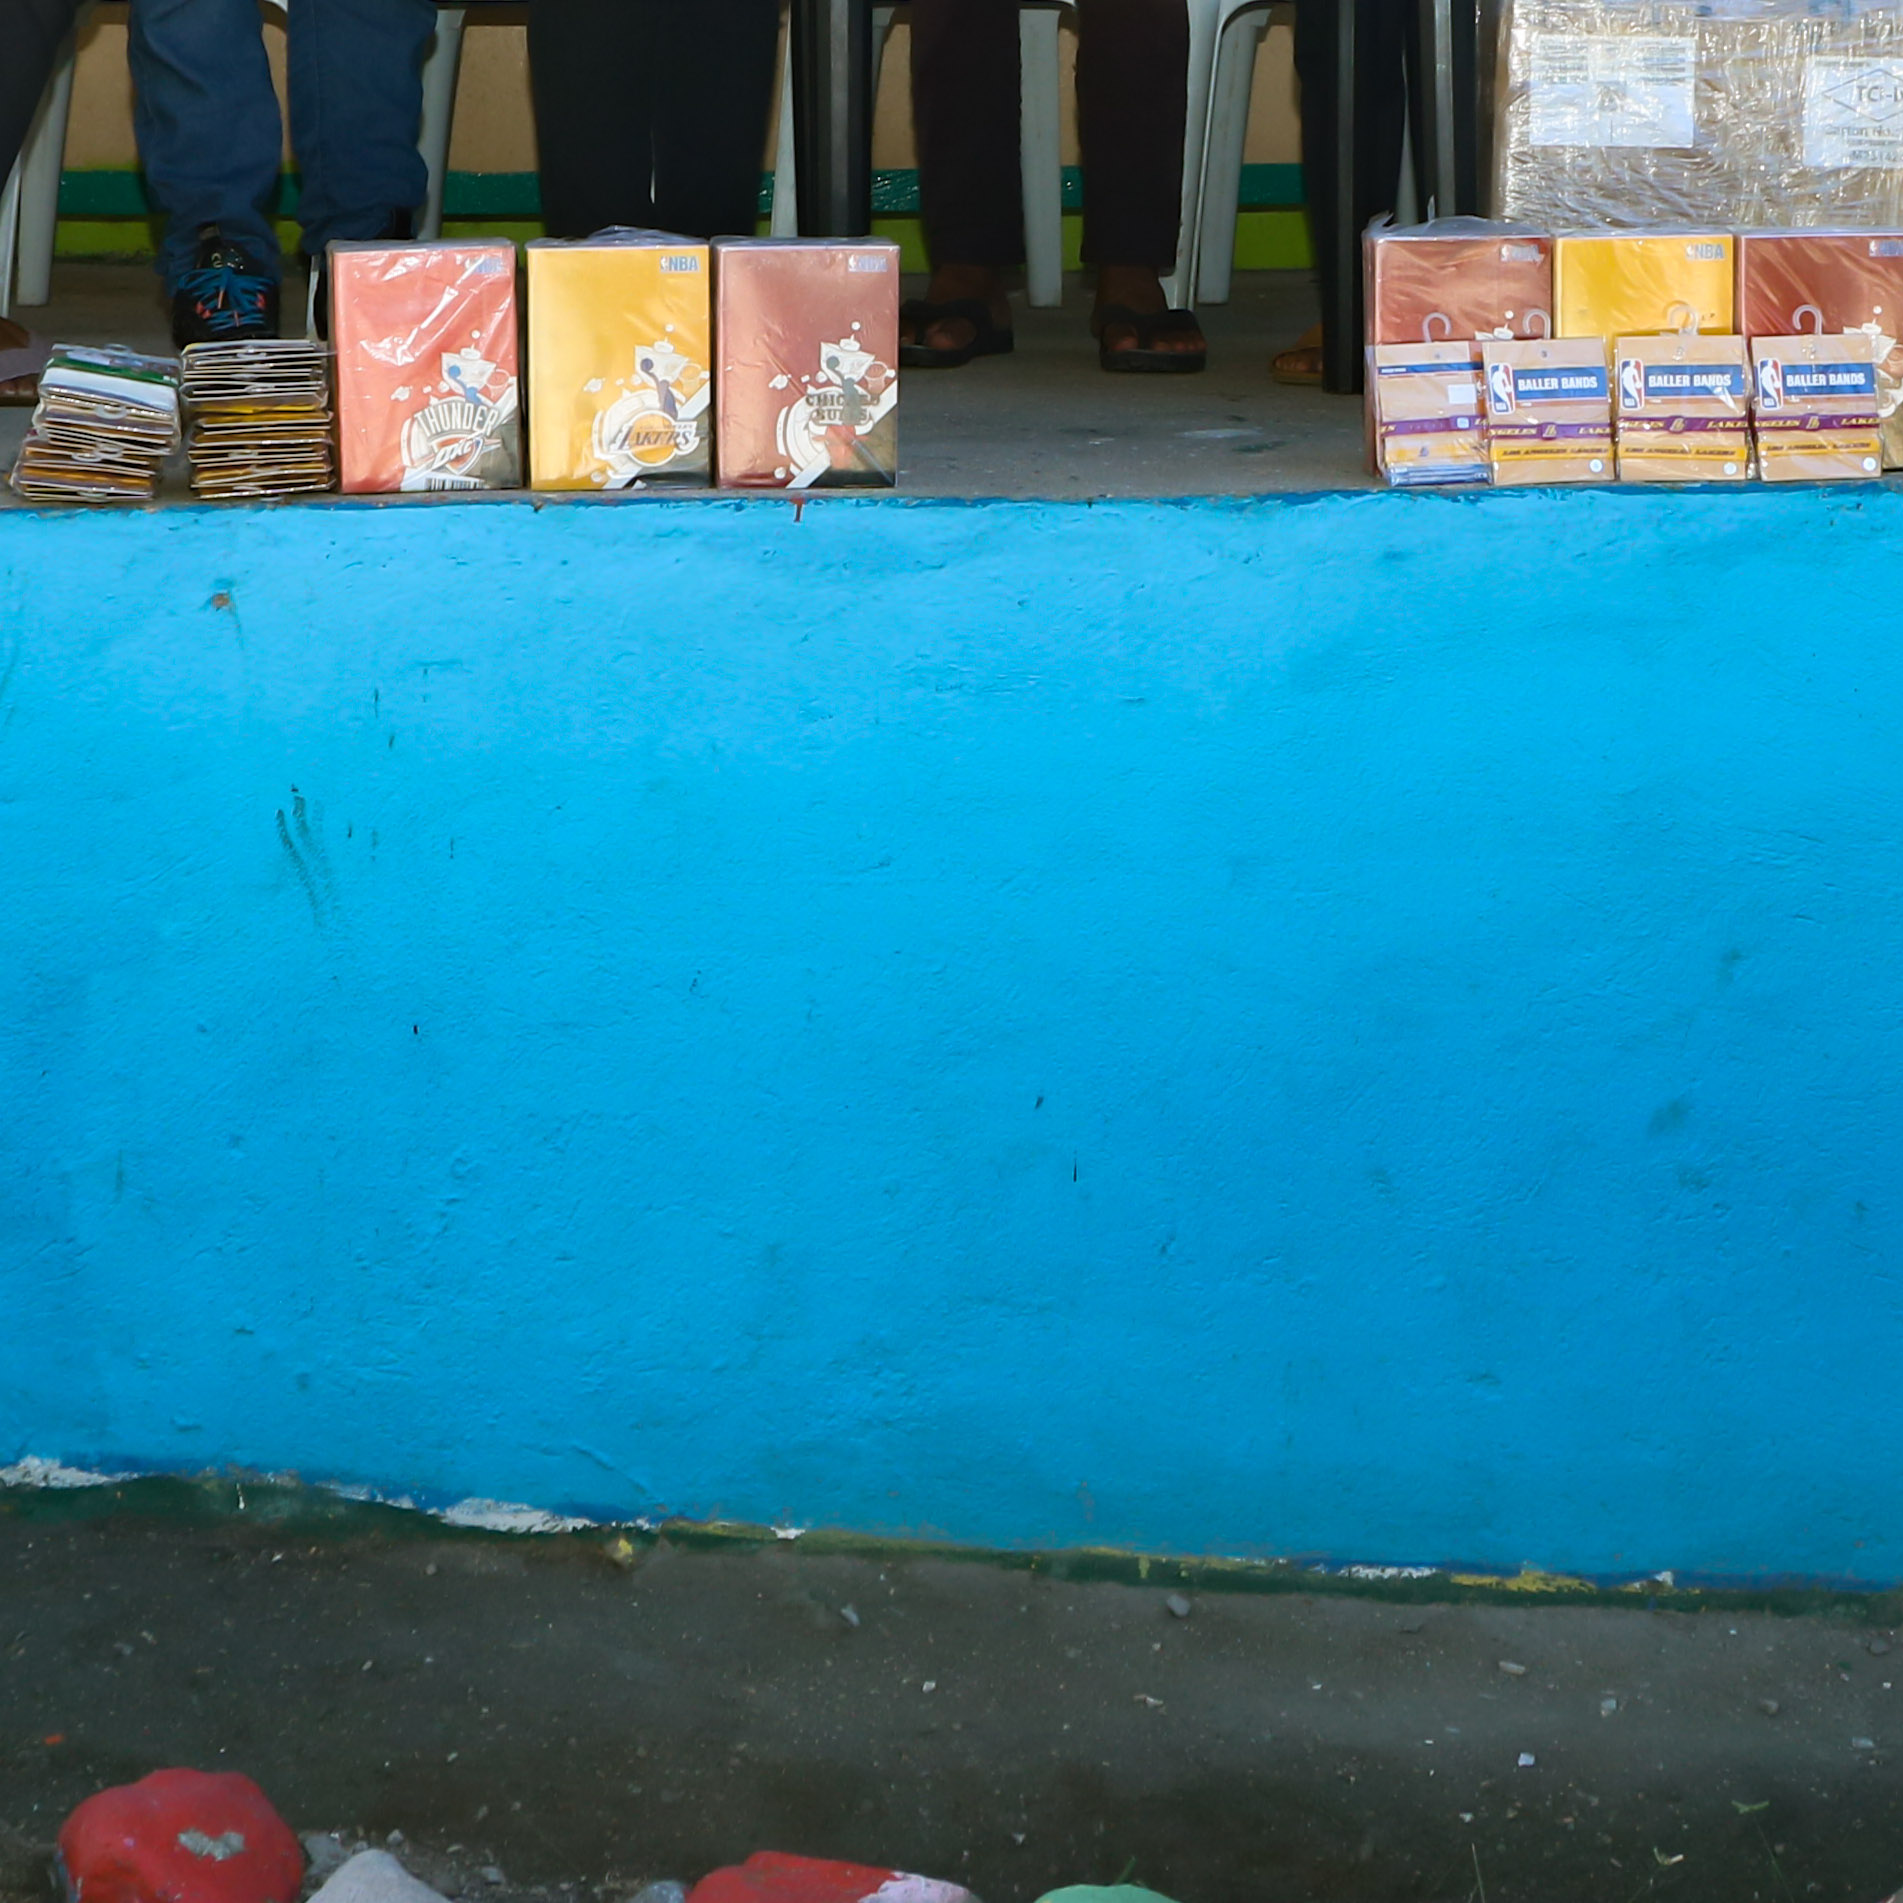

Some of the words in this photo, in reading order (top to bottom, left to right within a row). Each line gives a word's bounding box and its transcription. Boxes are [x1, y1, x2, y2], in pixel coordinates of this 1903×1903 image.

[1694, 243, 1725, 260] NBA
[668, 255, 699, 272] NBA
[1517, 377, 1559, 393] BALLER
[1561, 375, 1598, 390] BANDS
[1648, 374, 1691, 388] BALLER
[1693, 373, 1732, 388] BANDS
[1786, 372, 1827, 388] BALLER
[1829, 372, 1866, 386] BANDS
[413, 402, 500, 437] THUNDER
[616, 425, 693, 450] LAKERS
